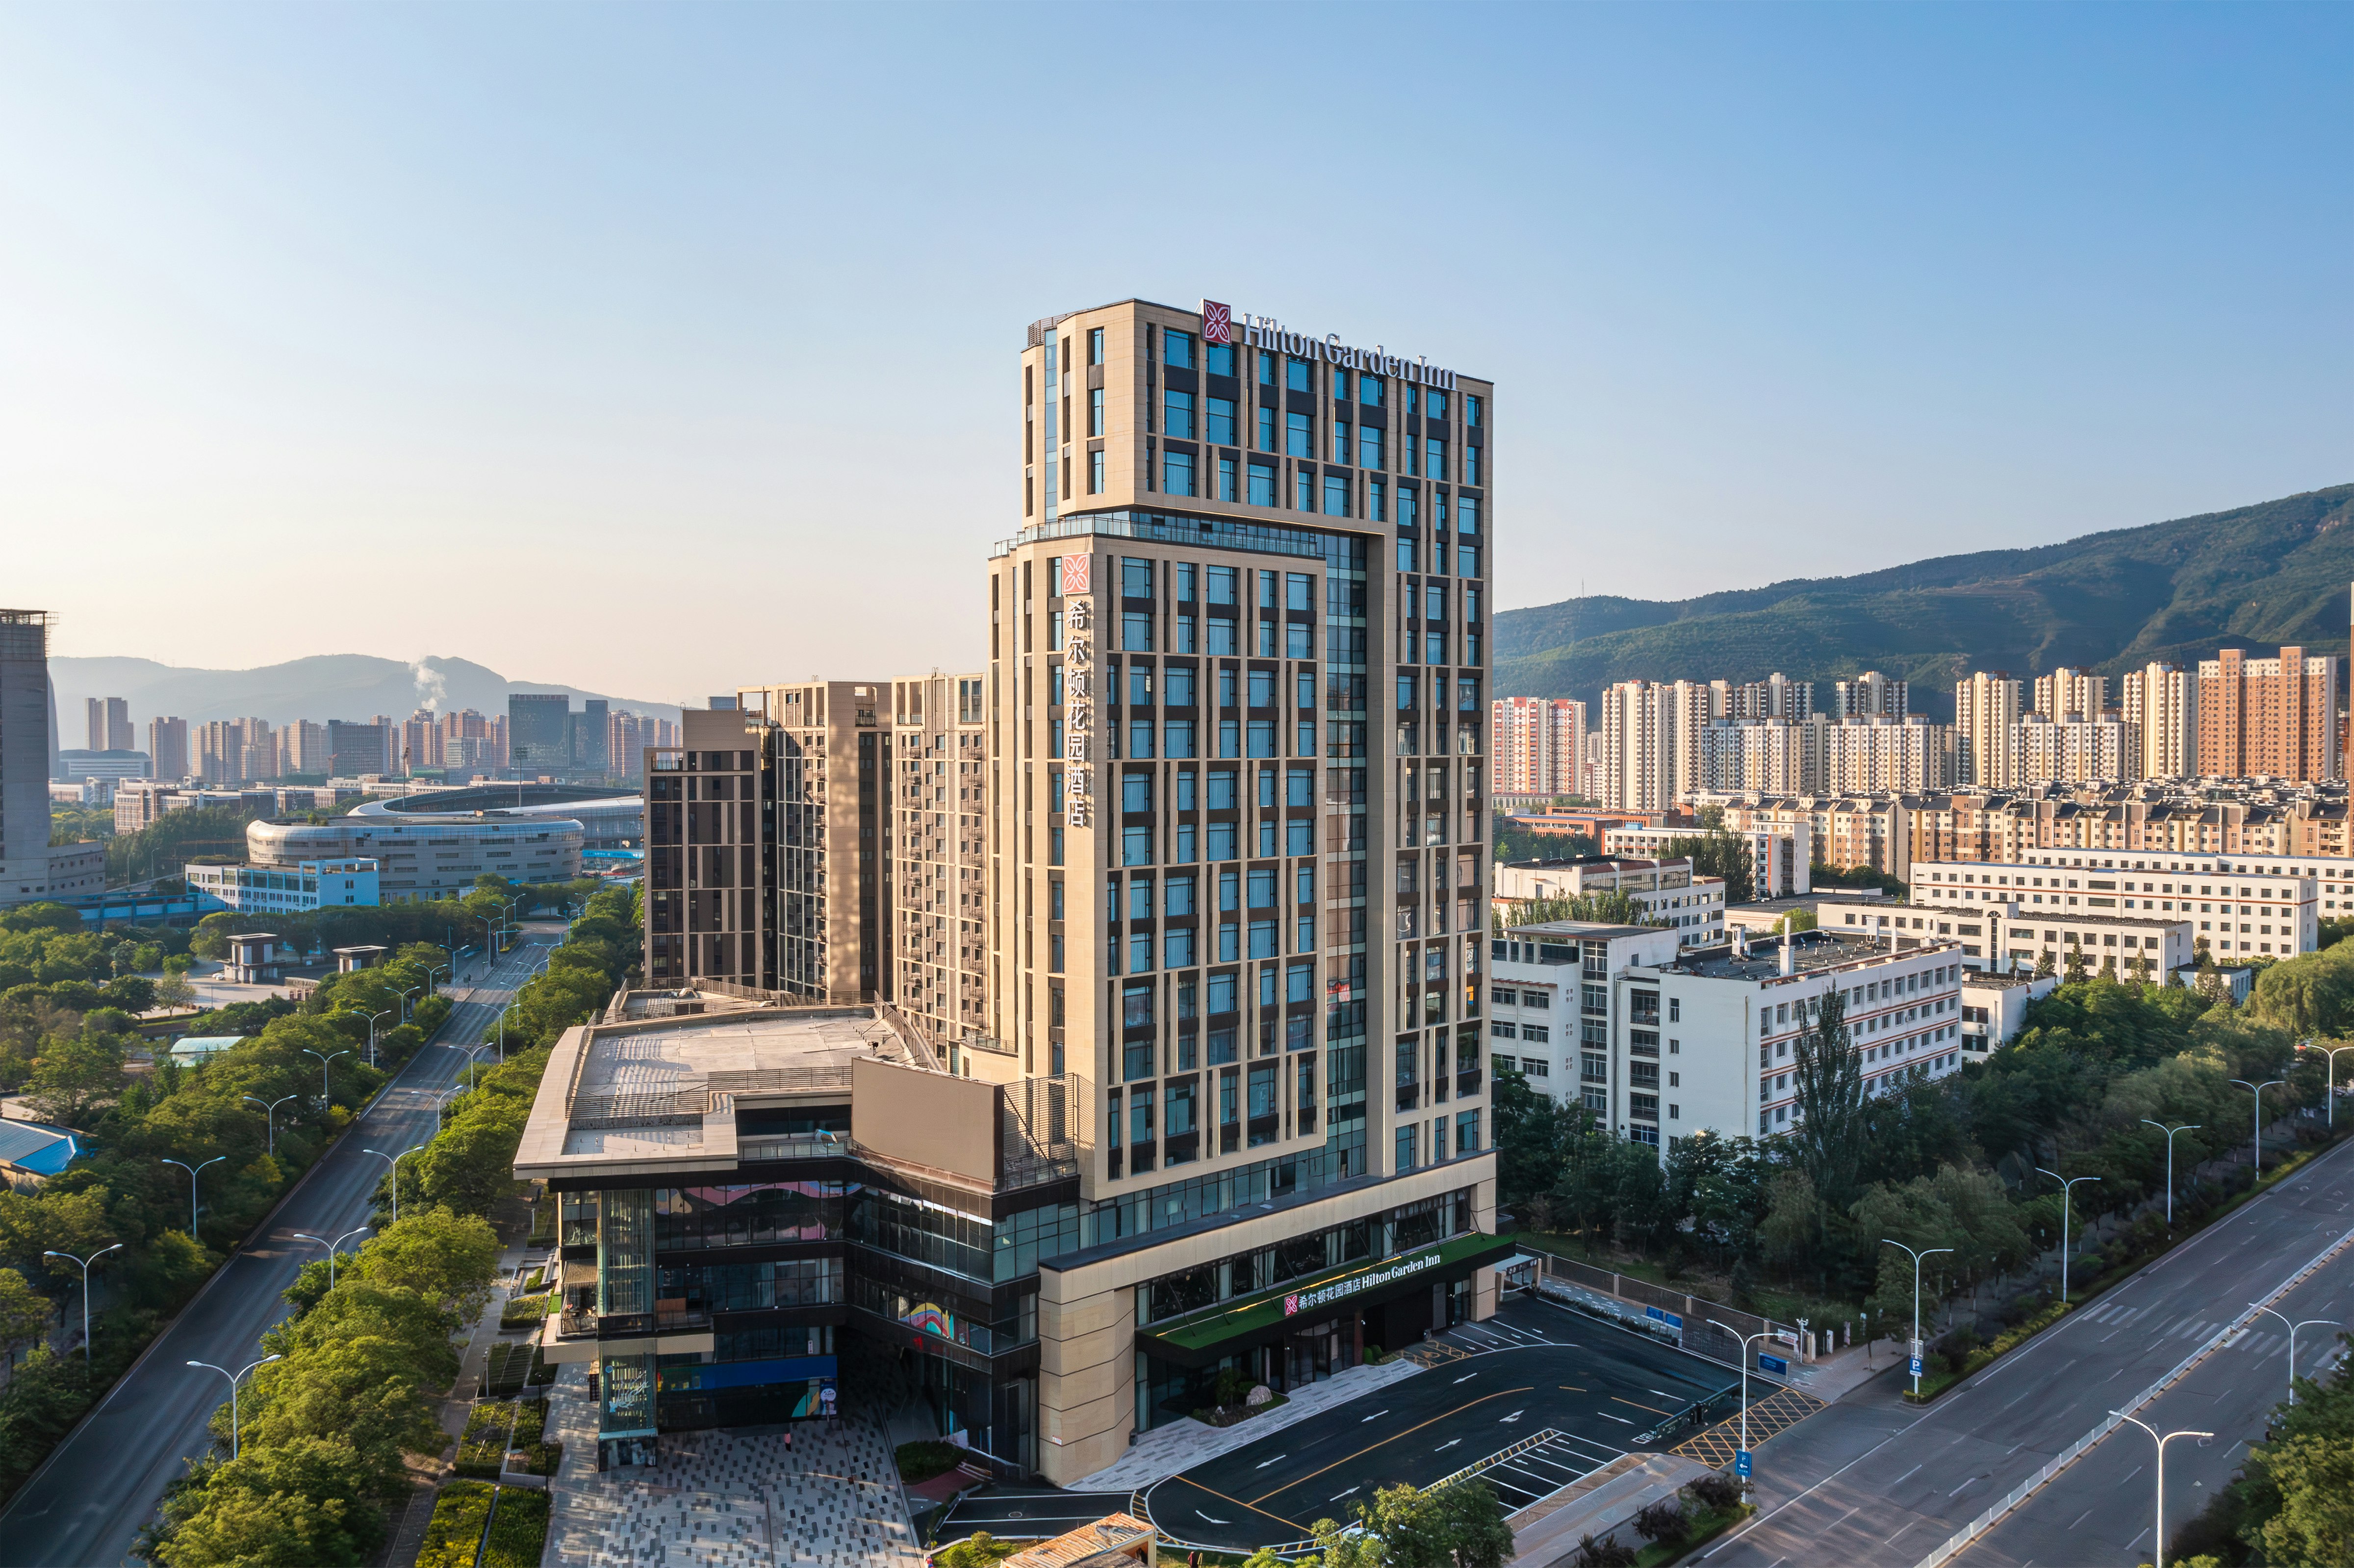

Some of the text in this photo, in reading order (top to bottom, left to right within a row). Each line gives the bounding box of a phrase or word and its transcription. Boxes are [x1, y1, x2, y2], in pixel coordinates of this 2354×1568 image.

[1242, 313, 1458, 391] Hilton Garden Inn
[1066, 600, 1085, 826] 希尔顿花园酒店
[1299, 1255, 1440, 1309] 希尔顿花园酒店 Hilton Garden Inn
[1912, 1360, 1920, 1370] P
